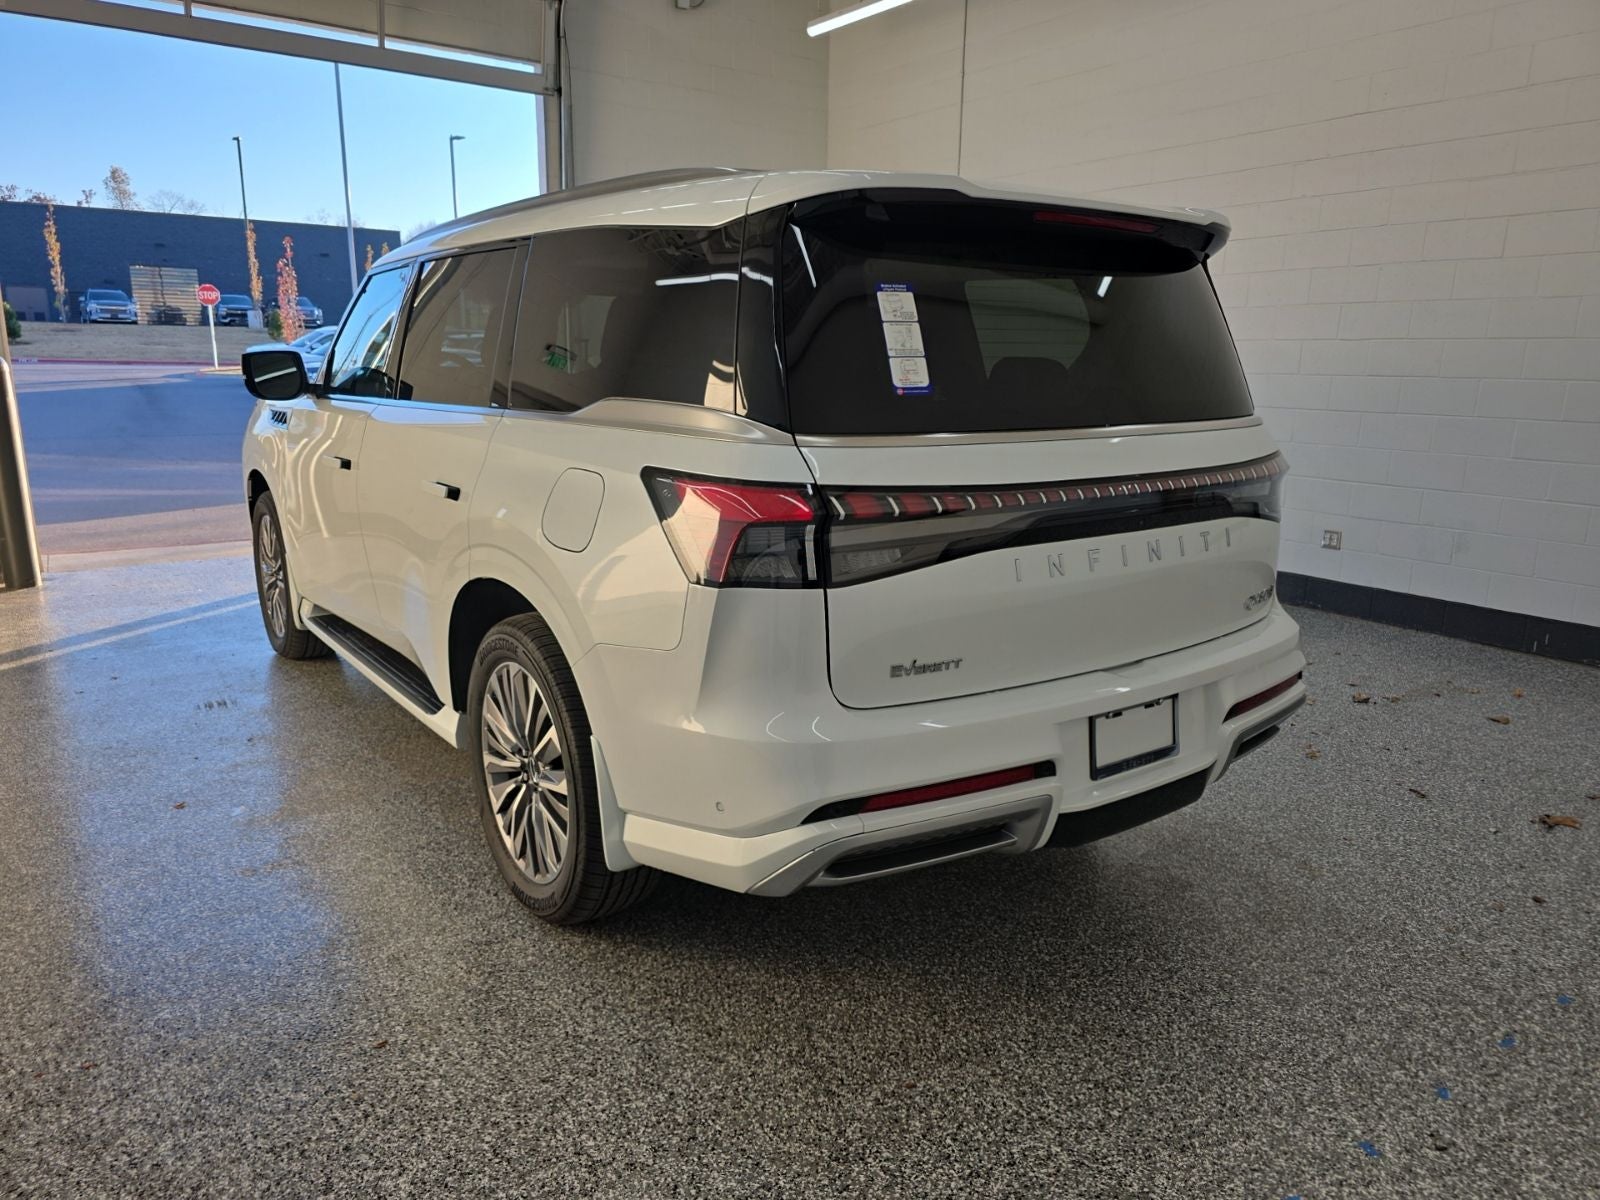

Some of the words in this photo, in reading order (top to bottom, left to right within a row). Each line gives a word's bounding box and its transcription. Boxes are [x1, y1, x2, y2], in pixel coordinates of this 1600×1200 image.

[198, 290, 218, 300] STOP
[1013, 527, 1231, 583] INFINITI
[889, 658, 963, 678] EVERETT
